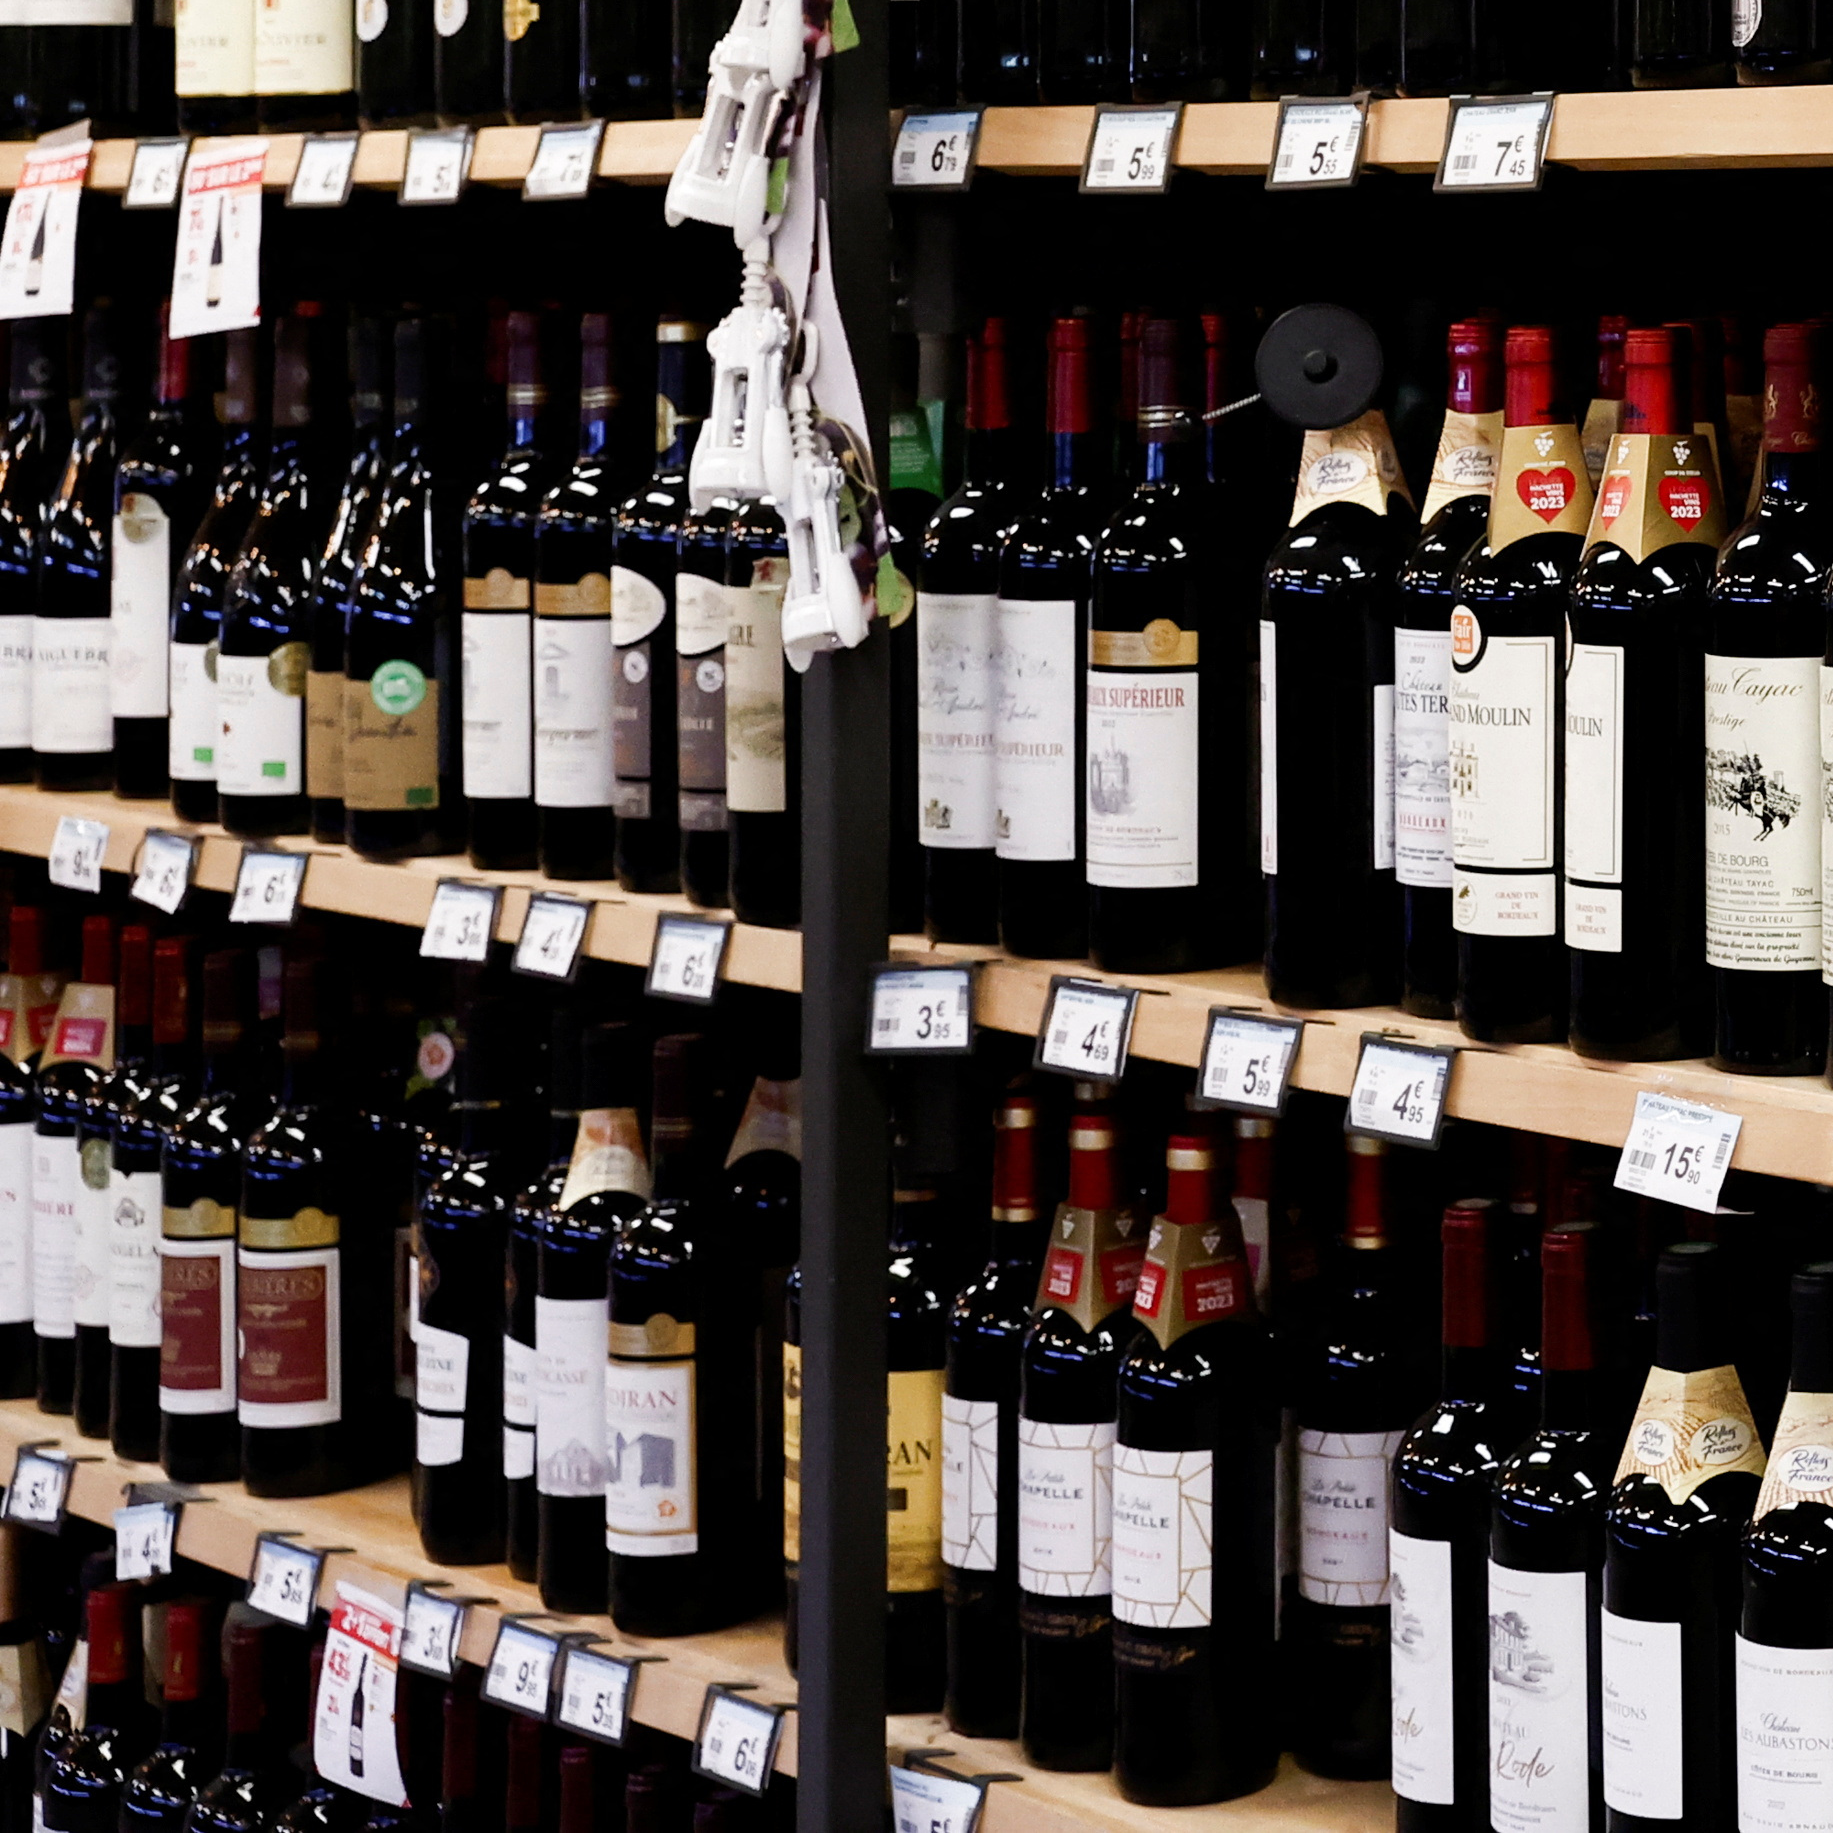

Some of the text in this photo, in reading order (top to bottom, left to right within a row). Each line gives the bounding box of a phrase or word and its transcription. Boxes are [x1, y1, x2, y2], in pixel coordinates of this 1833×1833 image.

[1530, 495, 1563, 510] 2023
[1109, 684, 1185, 708] SUPÉRIEUR
[1468, 705, 1531, 727] MOULIN
[1789, 1469, 1833, 1484] France
